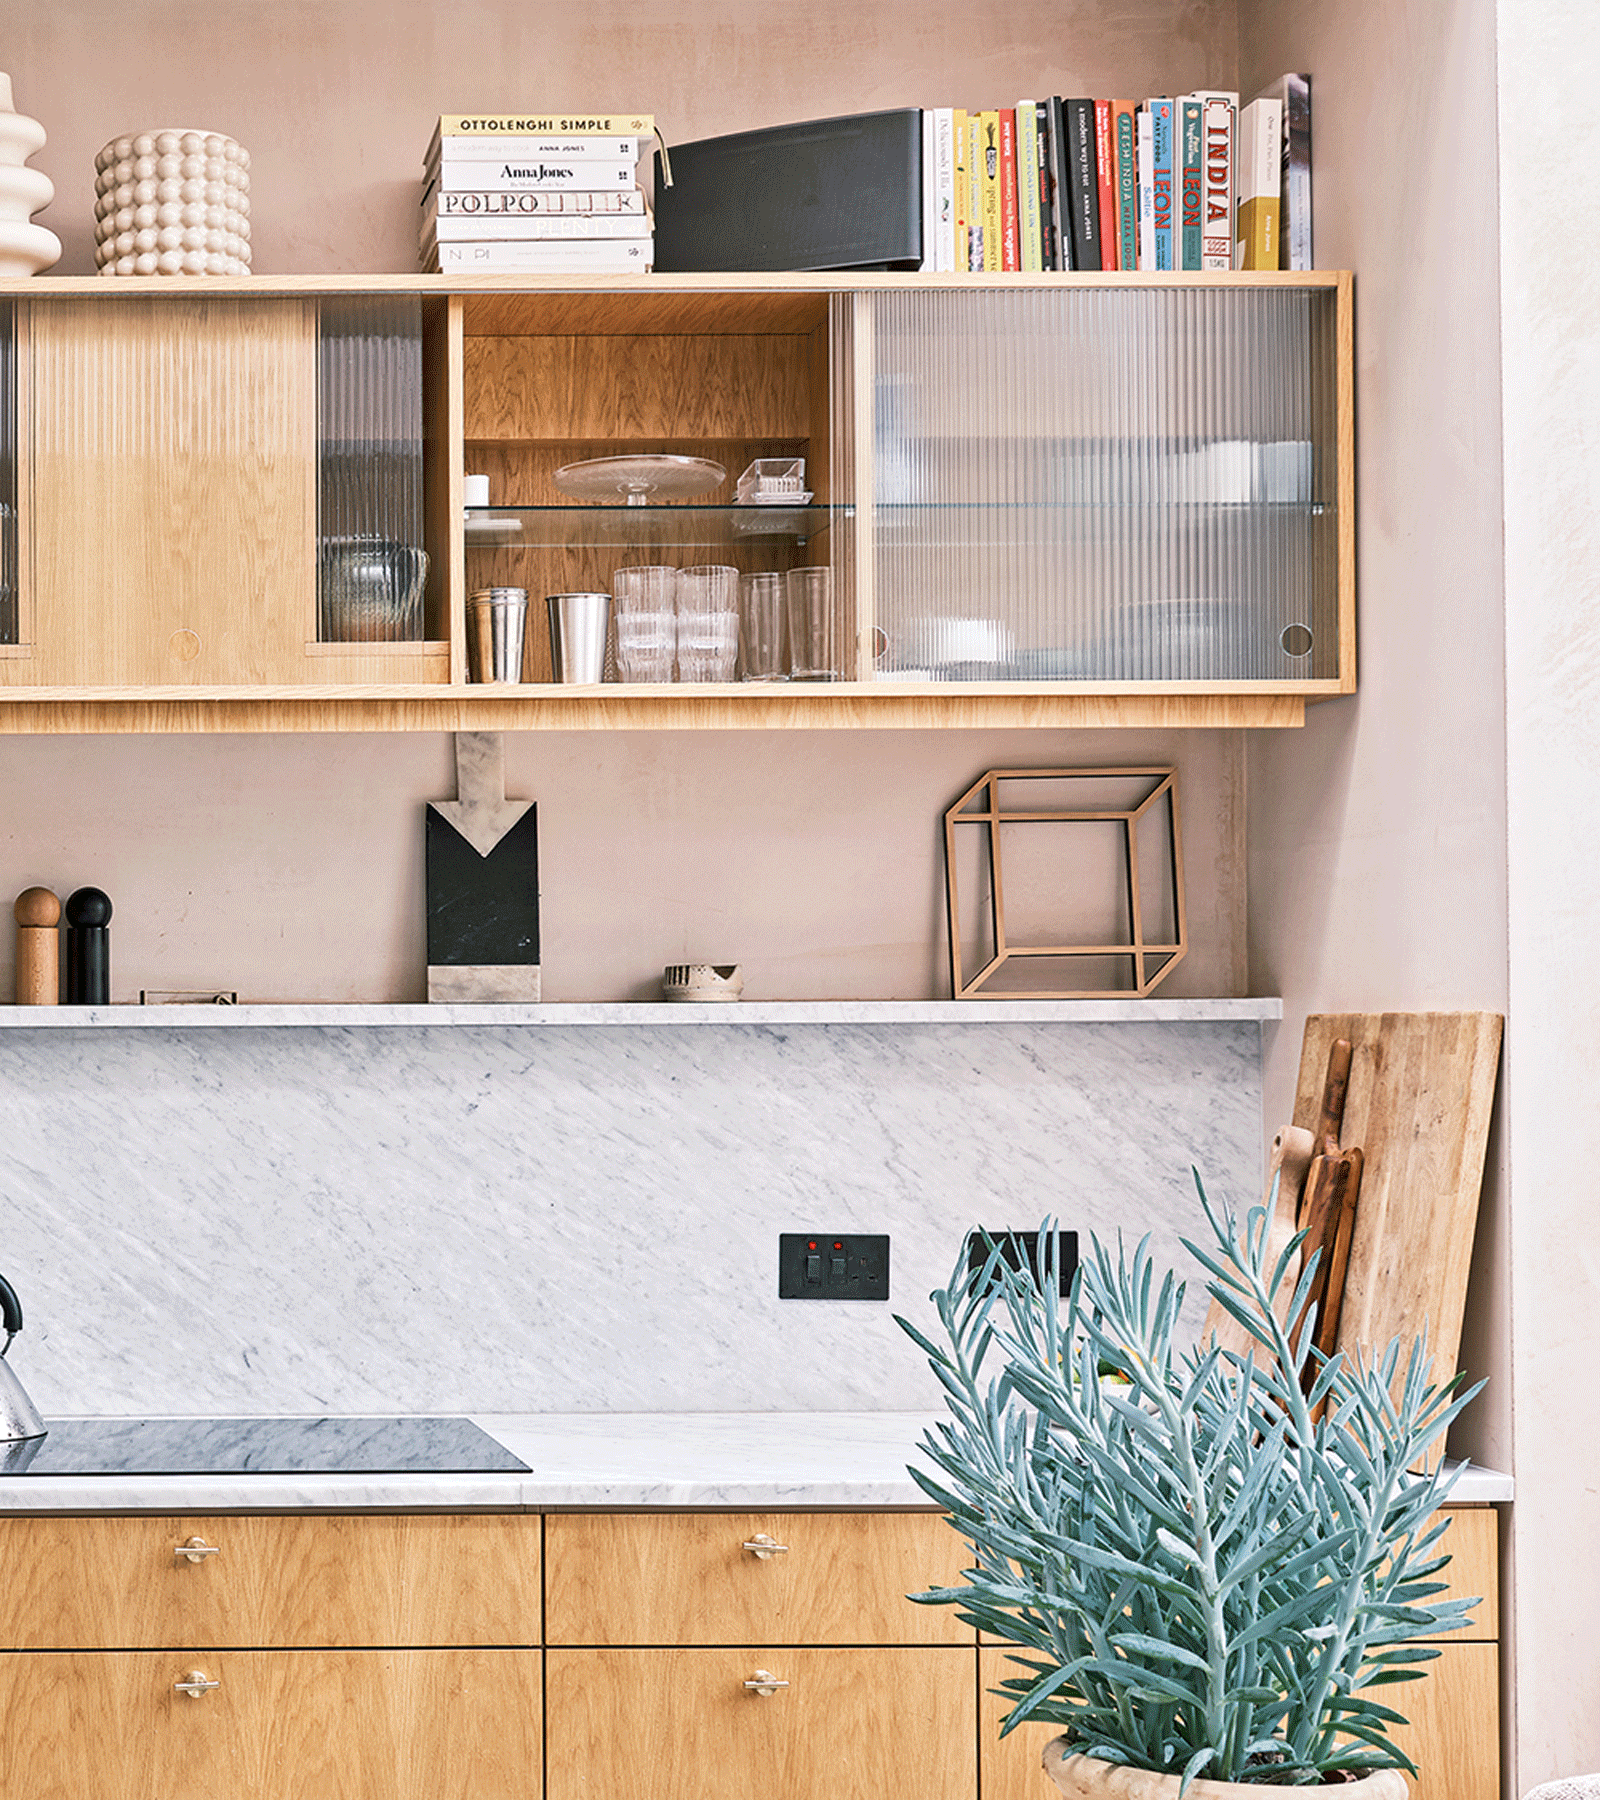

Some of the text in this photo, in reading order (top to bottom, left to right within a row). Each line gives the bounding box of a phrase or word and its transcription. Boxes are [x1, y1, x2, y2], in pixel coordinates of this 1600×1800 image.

[460, 119, 611, 130] OTTOLENGHI SIMPLE
[1079, 114, 1087, 145] modern
[1025, 131, 1034, 162] GREEN
[1079, 147, 1088, 163] way
[1120, 119, 1132, 202] FRESH INDIA
[1081, 164, 1089, 172] to
[1207, 126, 1229, 224] INDIA
[1026, 164, 1035, 210] ROASTING
[1154, 169, 1171, 229] LEON
[1183, 167, 1201, 226] LEON
[446, 194, 538, 213] POLPO
[1084, 217, 1092, 239] JONES
